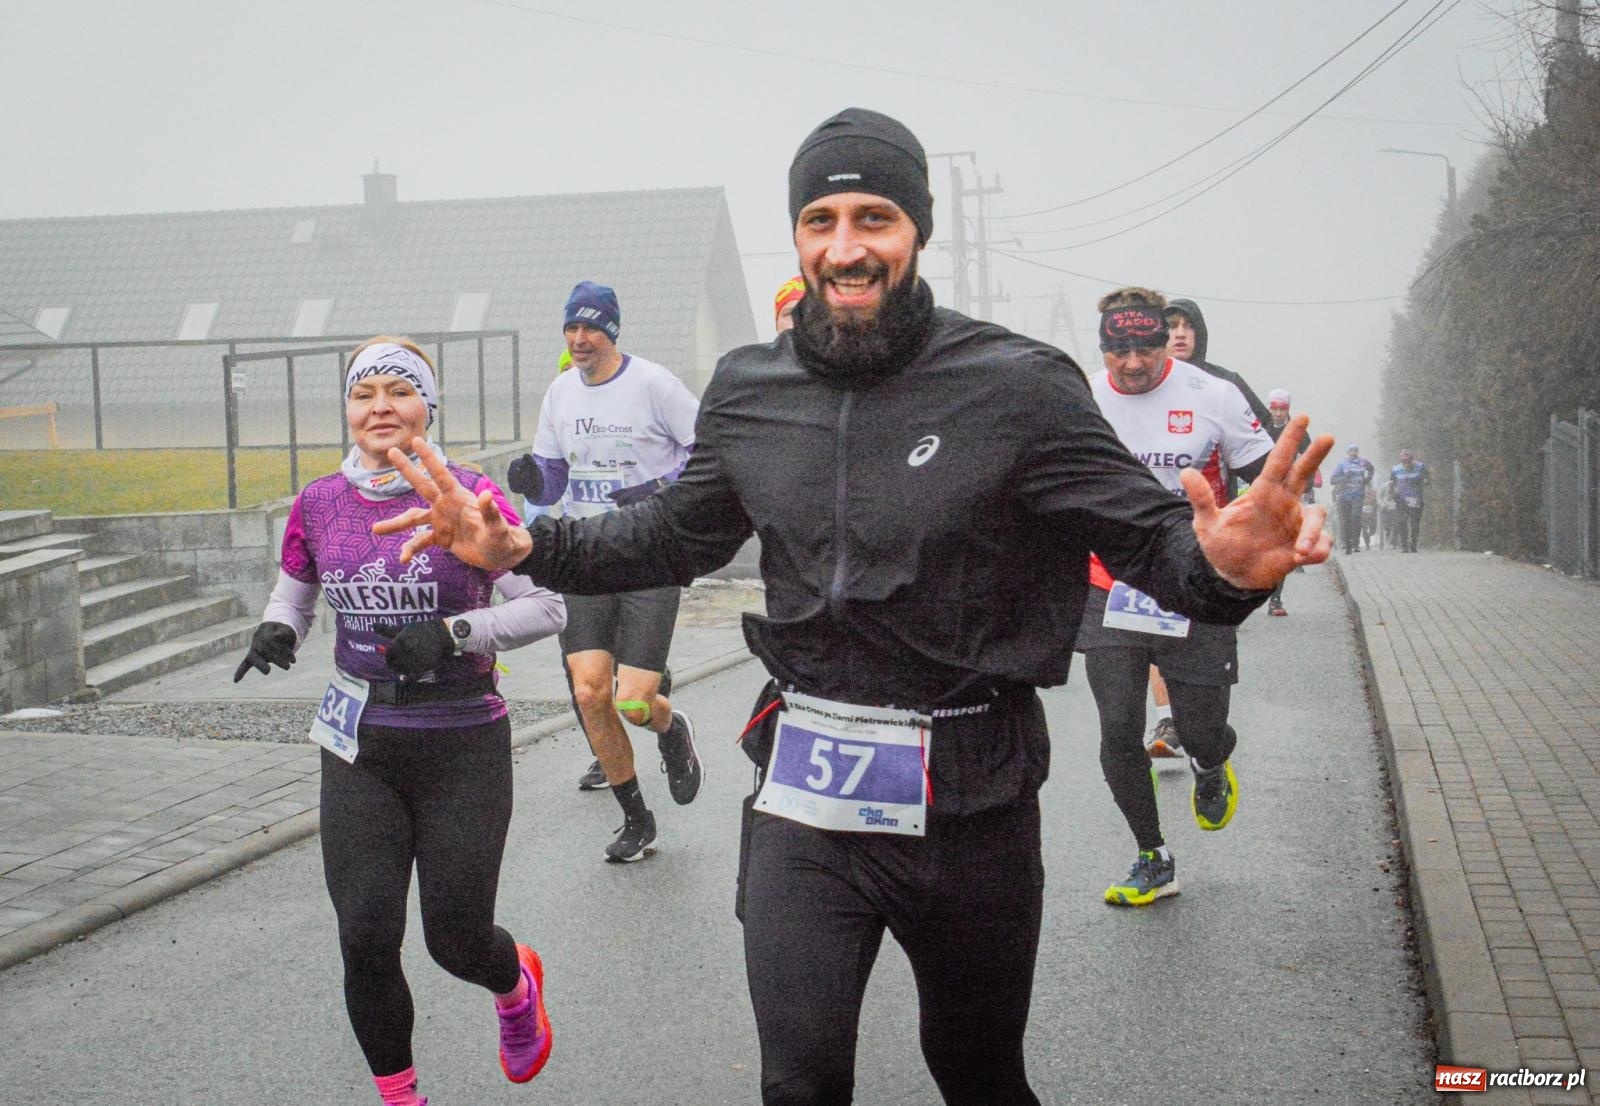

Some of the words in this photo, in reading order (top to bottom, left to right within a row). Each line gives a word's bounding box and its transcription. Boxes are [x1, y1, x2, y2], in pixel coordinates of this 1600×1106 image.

[575, 417, 594, 435] IV
[592, 424, 633, 434] Eko-Cross
[579, 481, 613, 502] 118
[325, 585, 434, 610] SILESIAN
[322, 687, 349, 731] 34
[805, 737, 876, 795] 57
